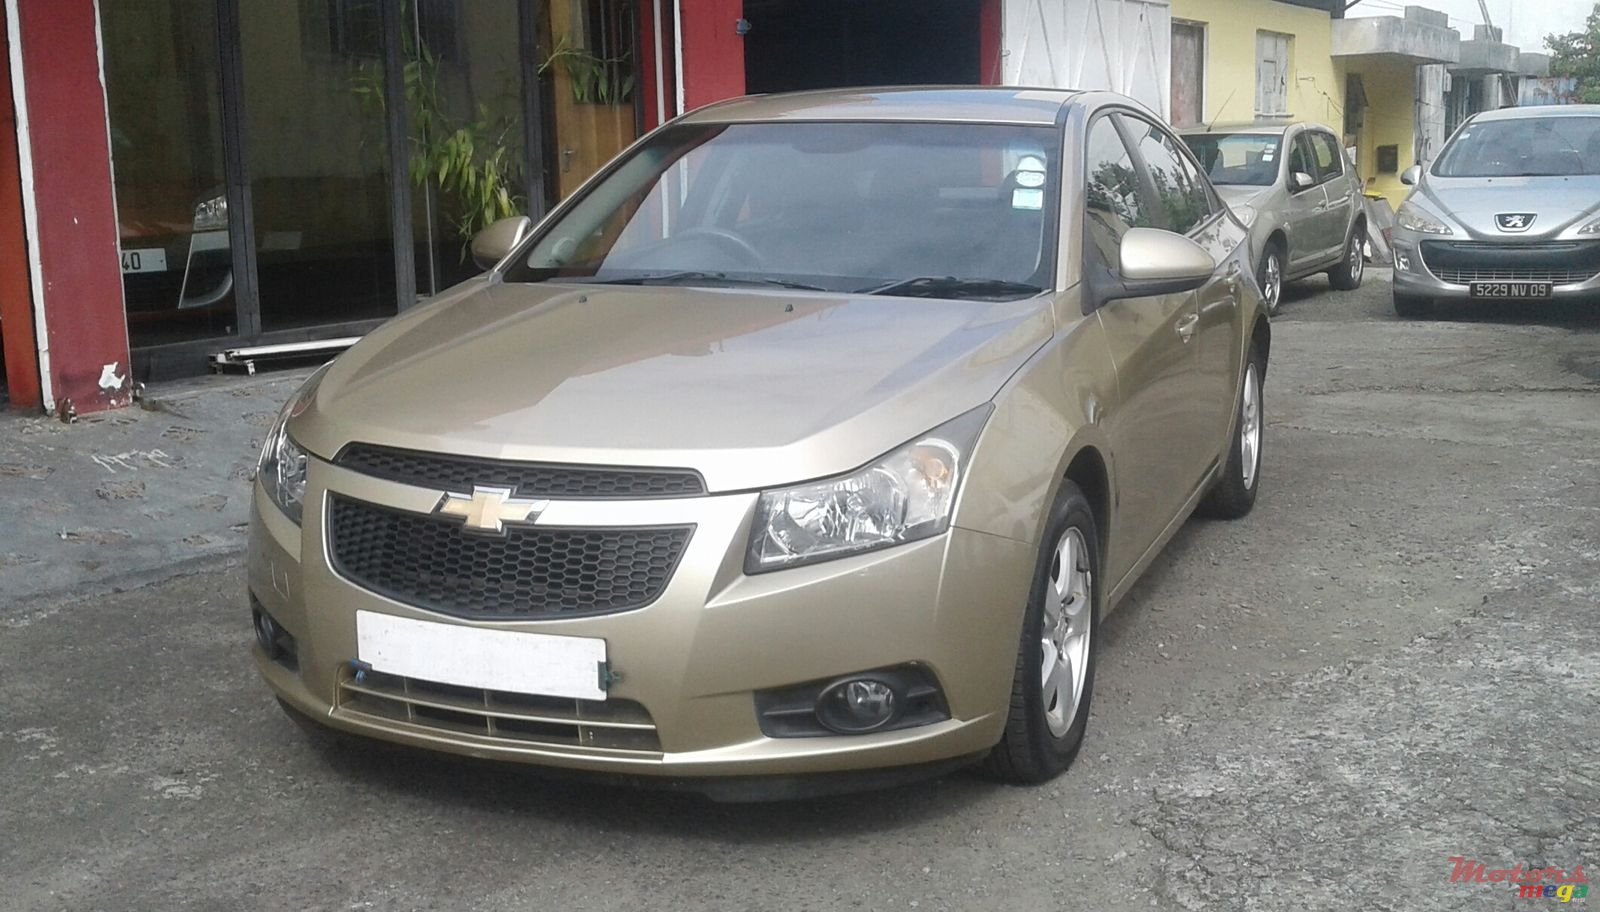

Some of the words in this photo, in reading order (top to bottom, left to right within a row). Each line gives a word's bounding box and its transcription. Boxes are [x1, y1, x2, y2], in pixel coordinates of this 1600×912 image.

[1476, 283, 1508, 297] 5229
[1511, 283, 1527, 297] NV
[1530, 283, 1547, 297] 09
